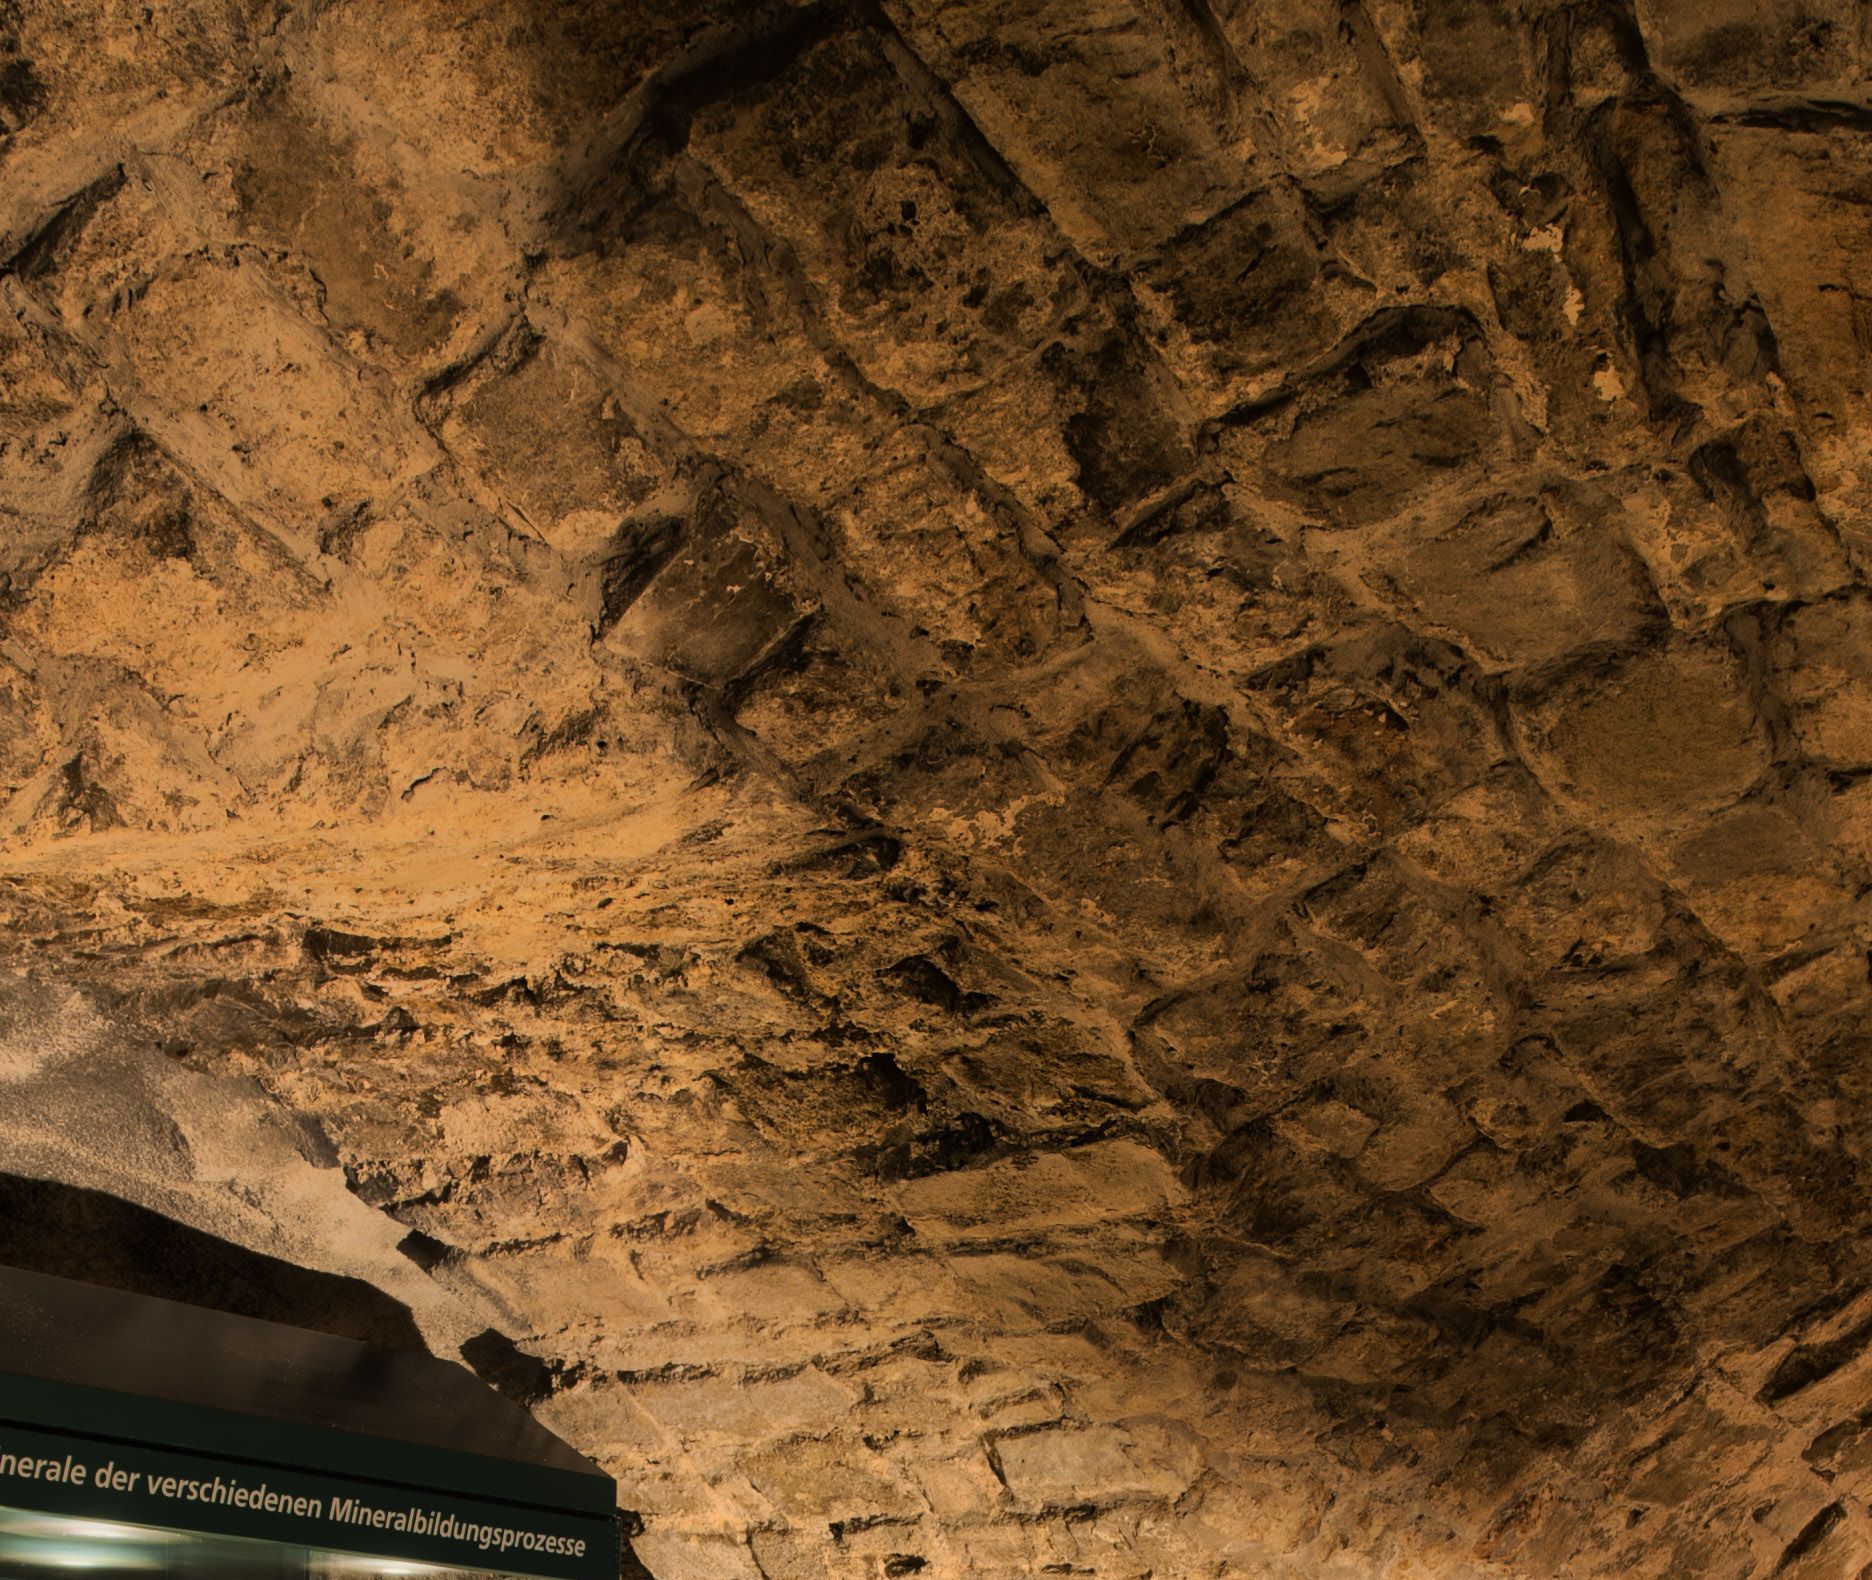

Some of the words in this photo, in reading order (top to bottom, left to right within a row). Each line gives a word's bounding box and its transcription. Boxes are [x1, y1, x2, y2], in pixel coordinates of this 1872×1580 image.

[95, 1461, 141, 1492] der
[148, 1475, 322, 1519] verschiedenen
[329, 1497, 586, 1557] Mineralbildungsprozesse
